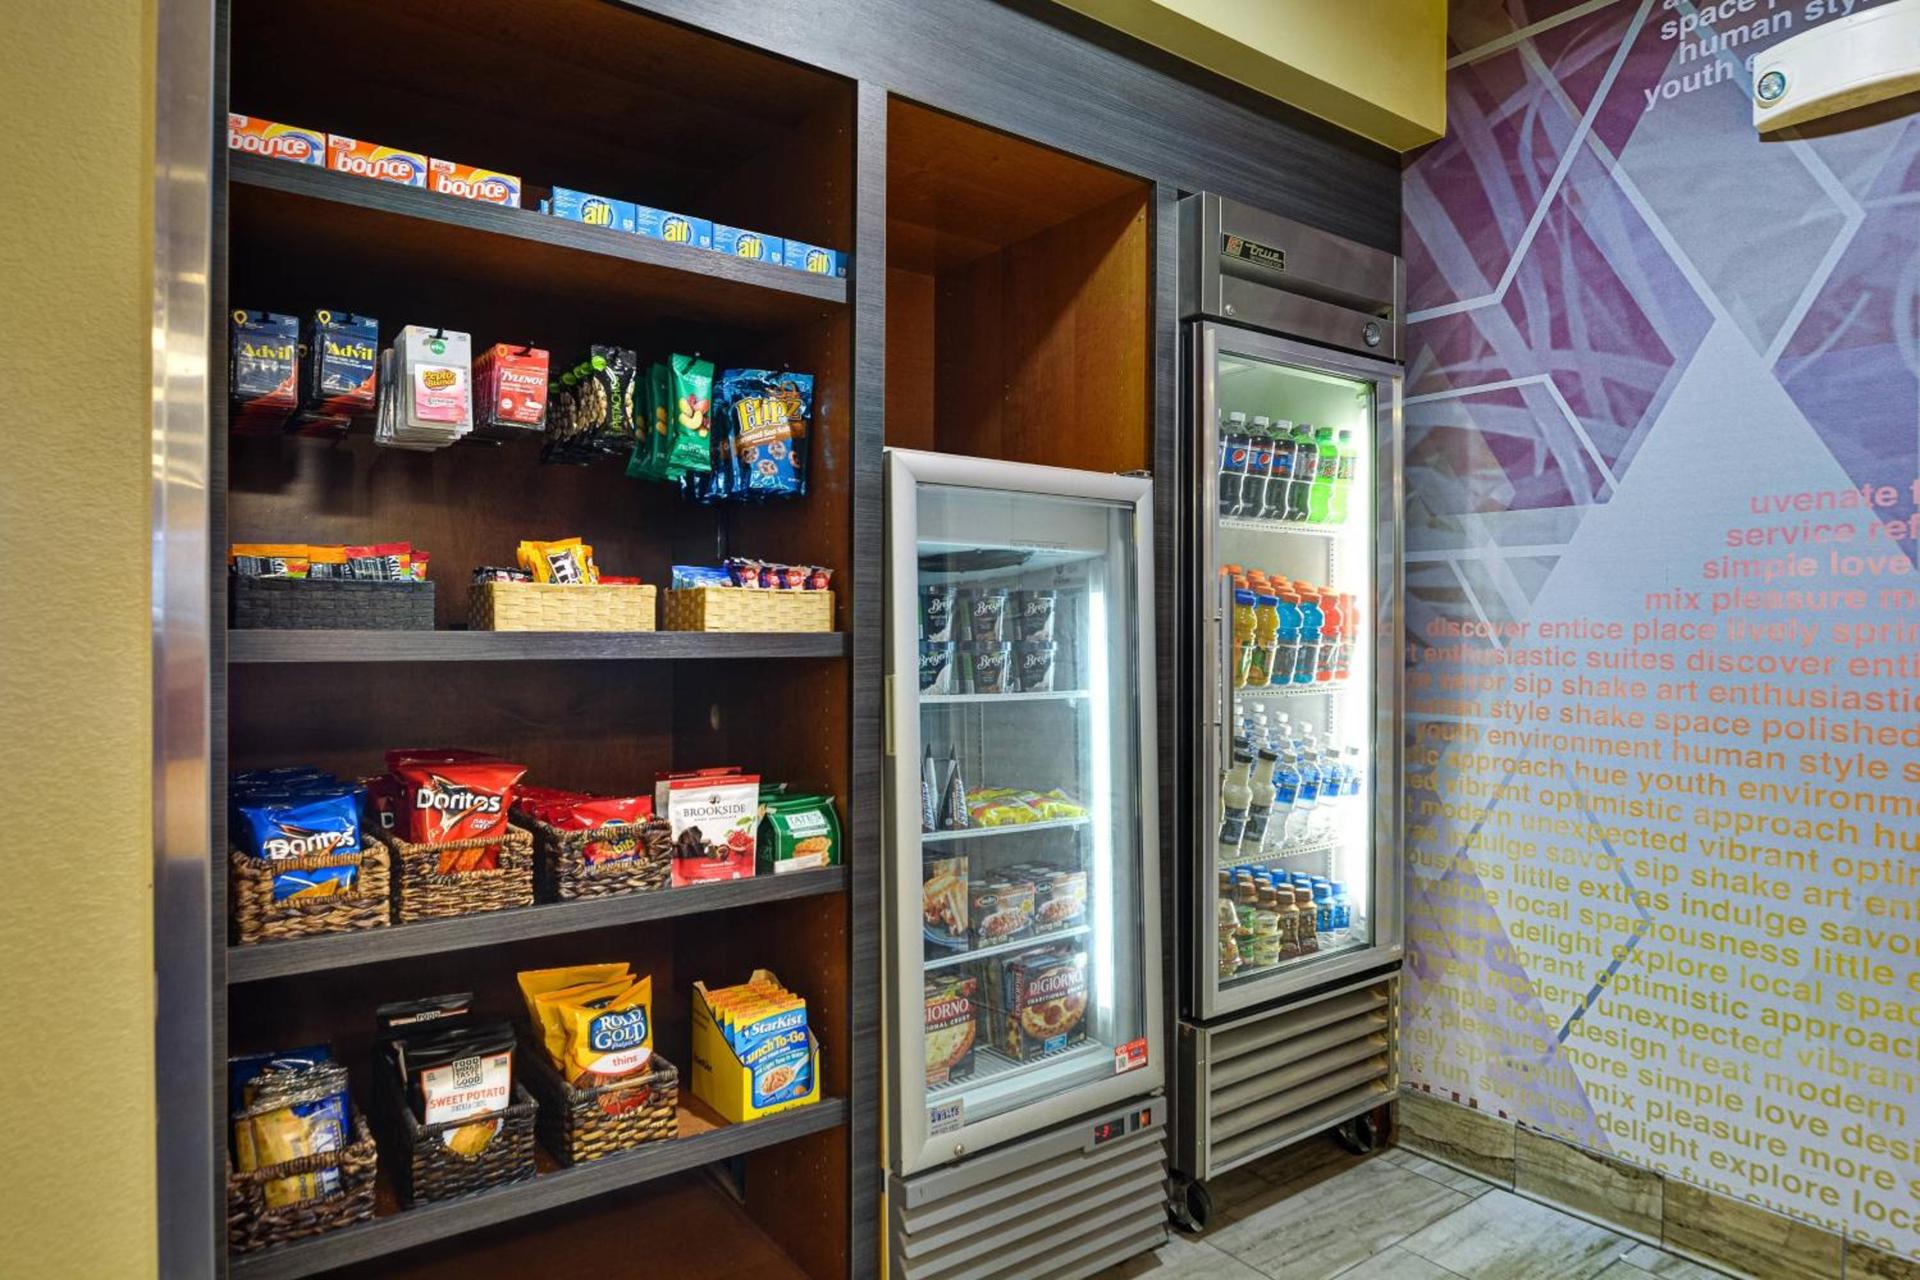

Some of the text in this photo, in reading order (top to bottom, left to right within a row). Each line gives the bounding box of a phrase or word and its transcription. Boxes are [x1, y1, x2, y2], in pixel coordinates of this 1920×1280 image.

[1660, 0, 1751, 40] space
[1679, 10, 1792, 64] human
[1805, 0, 1867, 22] sty
[1644, 58, 1734, 111] youth
[228, 128, 308, 155] bounce
[336, 151, 410, 178] bounce
[437, 174, 507, 200] bounce
[583, 203, 609, 225] all
[664, 220, 689, 244] all
[738, 238, 760, 261] all
[807, 253, 829, 273] all
[243, 343, 292, 361] Advil
[327, 341, 374, 361] Advil
[501, 371, 545, 387] TYLENOL
[1750, 483, 1899, 515] uvenate
[1726, 519, 1855, 548] service
[1703, 549, 1911, 584] simple love
[1645, 587, 1700, 611] mix
[1712, 586, 1867, 614] pleasure
[1538, 618, 1623, 640] entice
[1633, 618, 1716, 645] place
[1728, 618, 1819, 647] lively
[1586, 648, 1674, 671] suites
[1686, 650, 1837, 676] discover
[1513, 673, 1552, 698] sip
[1562, 675, 1647, 699] shake
[1656, 680, 1698, 702] art
[1490, 700, 1551, 725] style
[1559, 703, 1645, 730] shake
[1655, 711, 1750, 737] space
[1487, 728, 1662, 760] environment
[1672, 738, 1786, 771] human
[1800, 751, 1889, 784] style
[1444, 751, 1565, 780] approach
[1575, 759, 1628, 786] hue
[1637, 772, 1727, 797] youth
[1738, 781, 1920, 817] environm
[416, 788, 502, 813] Doritos
[683, 804, 746, 818] BROOKSIDE
[1445, 776, 1530, 804] vibrant
[1539, 788, 1683, 824] optimistic
[1693, 807, 1859, 845] approach
[263, 825, 356, 860] Doritos
[1520, 814, 1688, 854] unexpected
[1699, 836, 1819, 872] vibrant
[1545, 845, 1624, 873] savor
[1634, 857, 1680, 886] sip
[1690, 867, 1791, 901] shake
[1803, 885, 1852, 911] art
[1513, 863, 1570, 892] little
[1578, 880, 1670, 911] extras
[1681, 892, 1807, 939] indulge
[1507, 889, 1569, 921] local
[1579, 906, 1801, 968] spaciousness
[1813, 947, 1894, 987] little
[1510, 919, 1609, 957] delight
[1612, 944, 1727, 984] explore
[1740, 964, 1822, 1005] local
[1594, 970, 1749, 1021] optimistic
[600, 1008, 644, 1031] ROLD
[751, 1012, 803, 1036] StarKist
[1487, 970, 1588, 1009] modern
[1597, 998, 1783, 1060] unexpected
[1797, 1048, 1920, 1095] vibran
[594, 1022, 646, 1049] GOLD
[612, 1054, 638, 1067] thins
[1506, 998, 1561, 1030] love
[1568, 1017, 1666, 1061] design
[1678, 1043, 1751, 1085] treat
[1763, 1070, 1906, 1127] modern
[430, 1092, 465, 1110] SWEET
[466, 1086, 506, 1101] POTATO
[1556, 1043, 1629, 1079] more
[1638, 1066, 1744, 1113] simple
[1755, 1095, 1830, 1137] love
[1584, 1080, 1636, 1112] mix
[1646, 1098, 1788, 1159] pleasure
[1799, 1144, 1897, 1192] more
[1595, 1111, 1699, 1162] delight
[1709, 1151, 1841, 1207] explore
